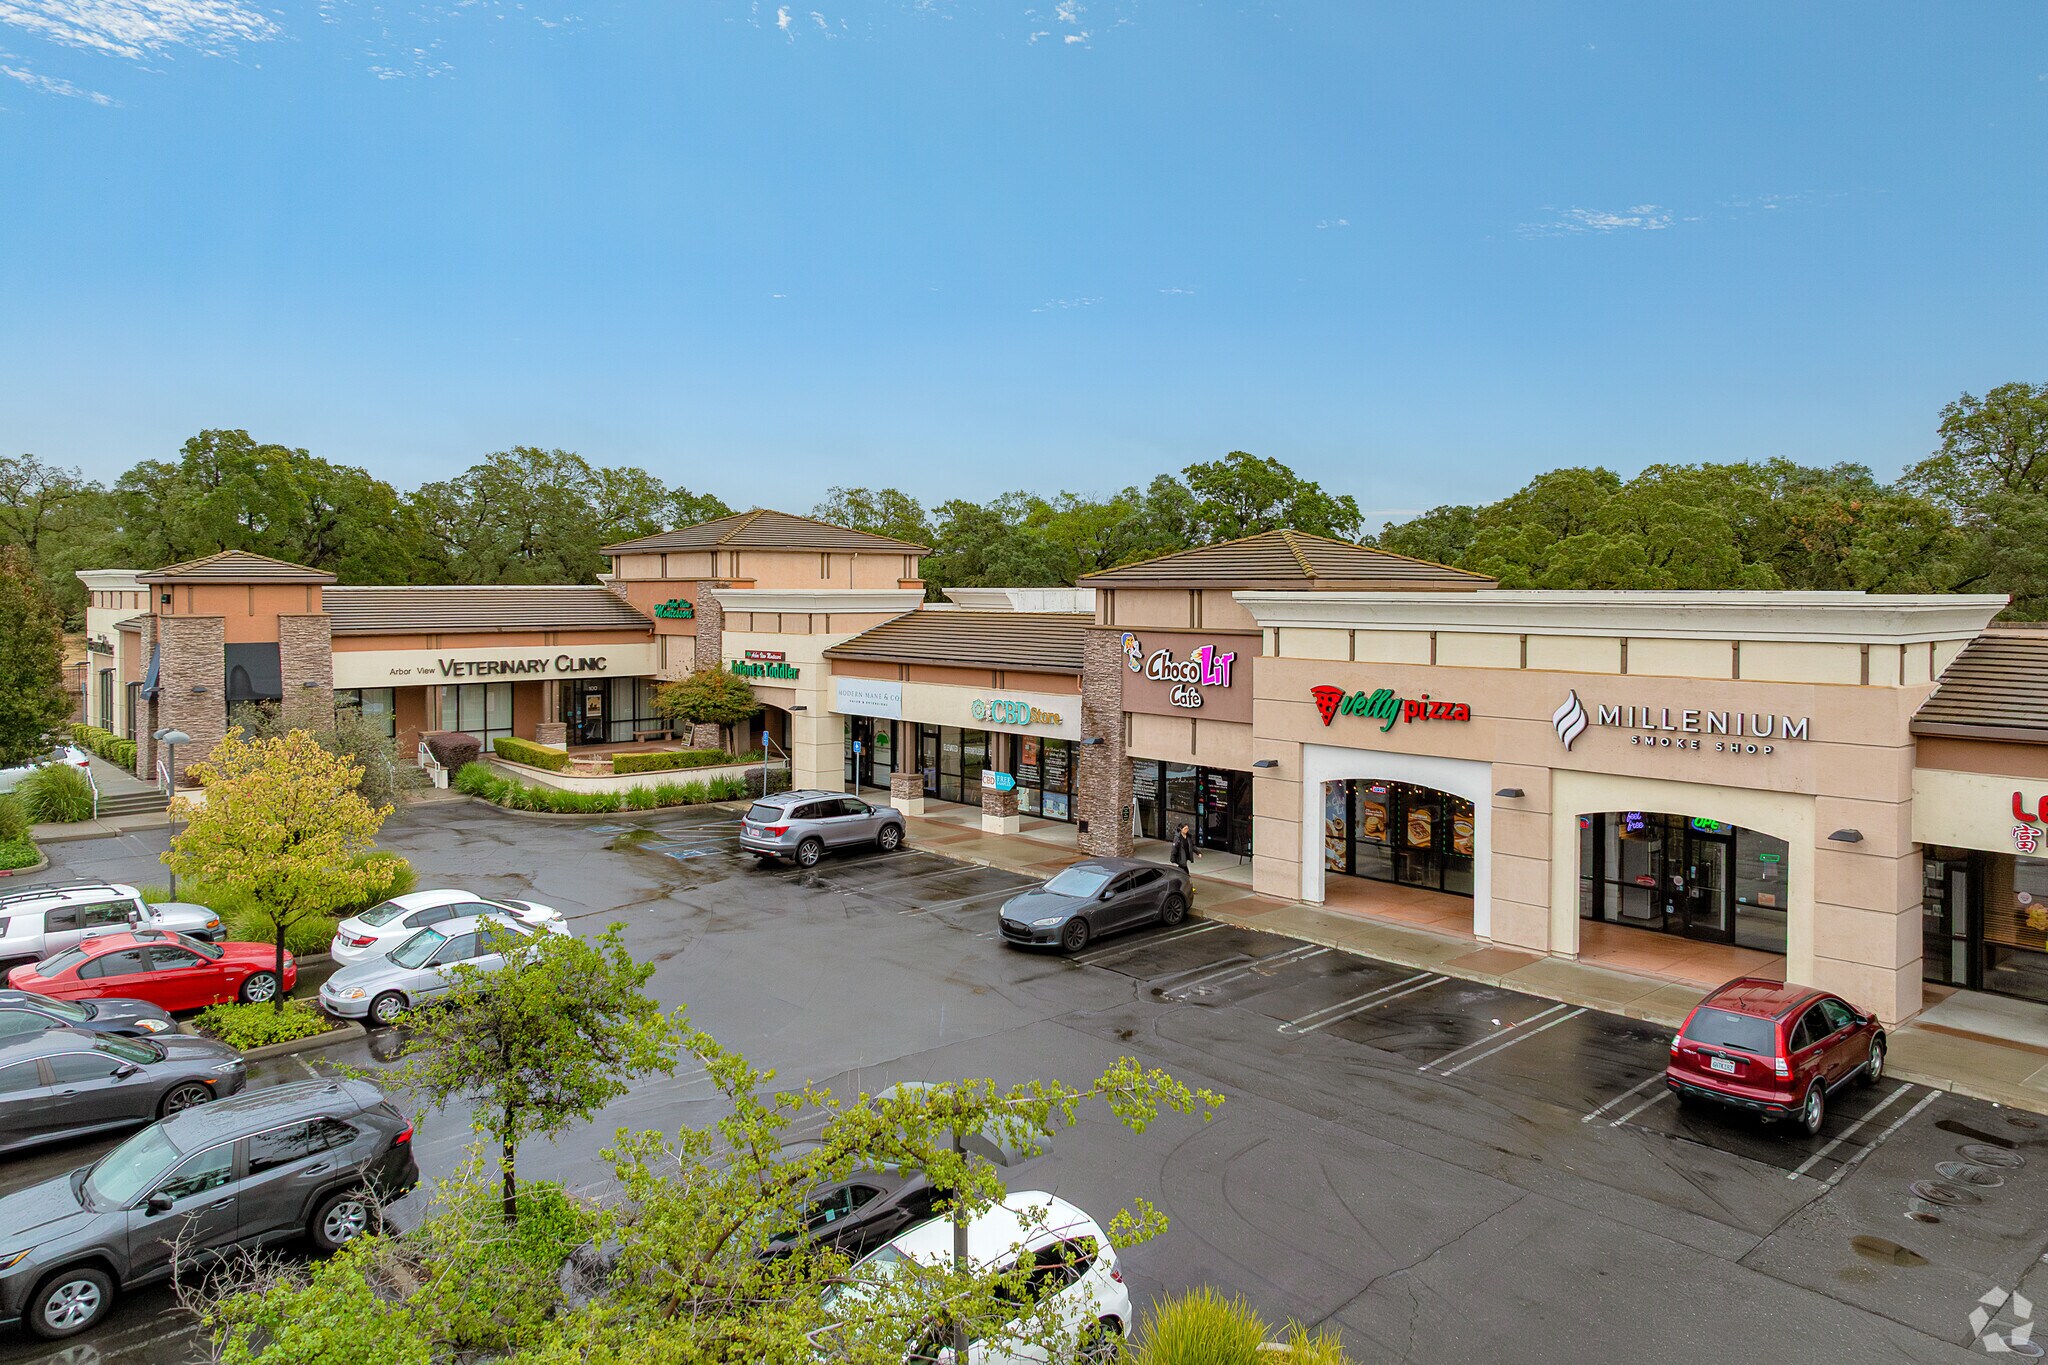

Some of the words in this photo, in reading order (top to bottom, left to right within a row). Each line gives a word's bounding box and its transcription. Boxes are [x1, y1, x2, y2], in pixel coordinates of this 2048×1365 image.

[654, 604, 694, 618] Montessori
[389, 668, 411, 676] Arbor
[417, 666, 436, 674] View
[765, 662, 800, 680] Toddler
[838, 690, 862, 698] MODERN
[1170, 684, 1202, 708] Cafe
[992, 700, 1031, 726] CBD
[1030, 707, 1063, 726] Store
[1404, 694, 1470, 724] pizza
[1598, 704, 1810, 740] MILLENIUM
[1631, 736, 1700, 750] SMOKE
[1716, 742, 1774, 755] SHOP
[982, 776, 994, 785] CBD
[1626, 812, 1642, 822] feel
[1627, 820, 1644, 831] free
[2011, 823, 2043, 854] 富
